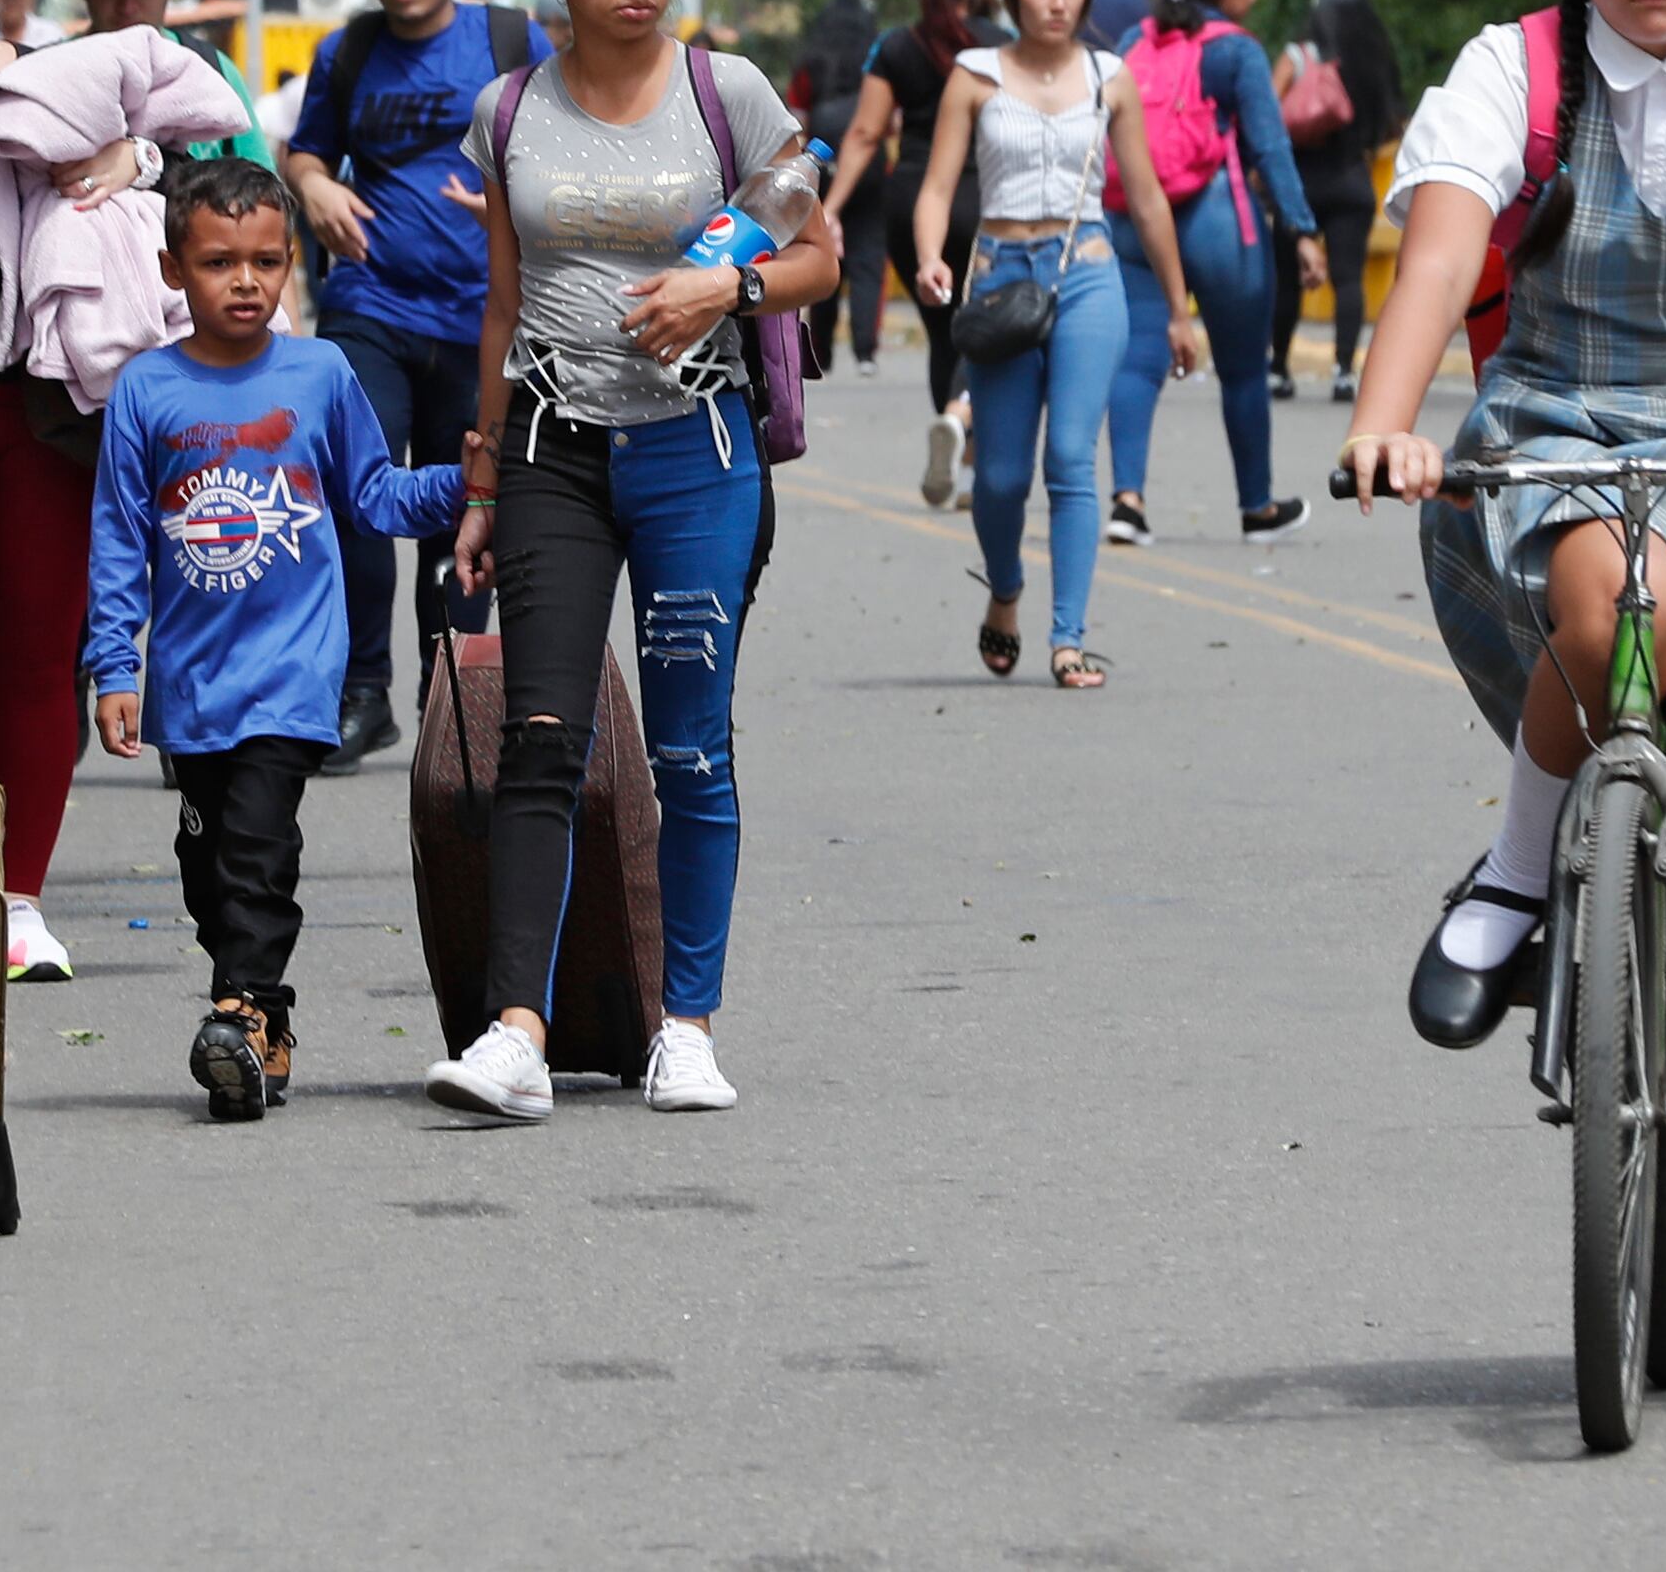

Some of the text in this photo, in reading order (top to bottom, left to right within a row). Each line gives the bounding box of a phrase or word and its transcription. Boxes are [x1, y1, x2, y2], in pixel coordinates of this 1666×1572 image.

[355, 89, 457, 143] NIKE
[176, 466, 266, 504] TOMMY
[173, 545, 276, 594] HILFIGER
